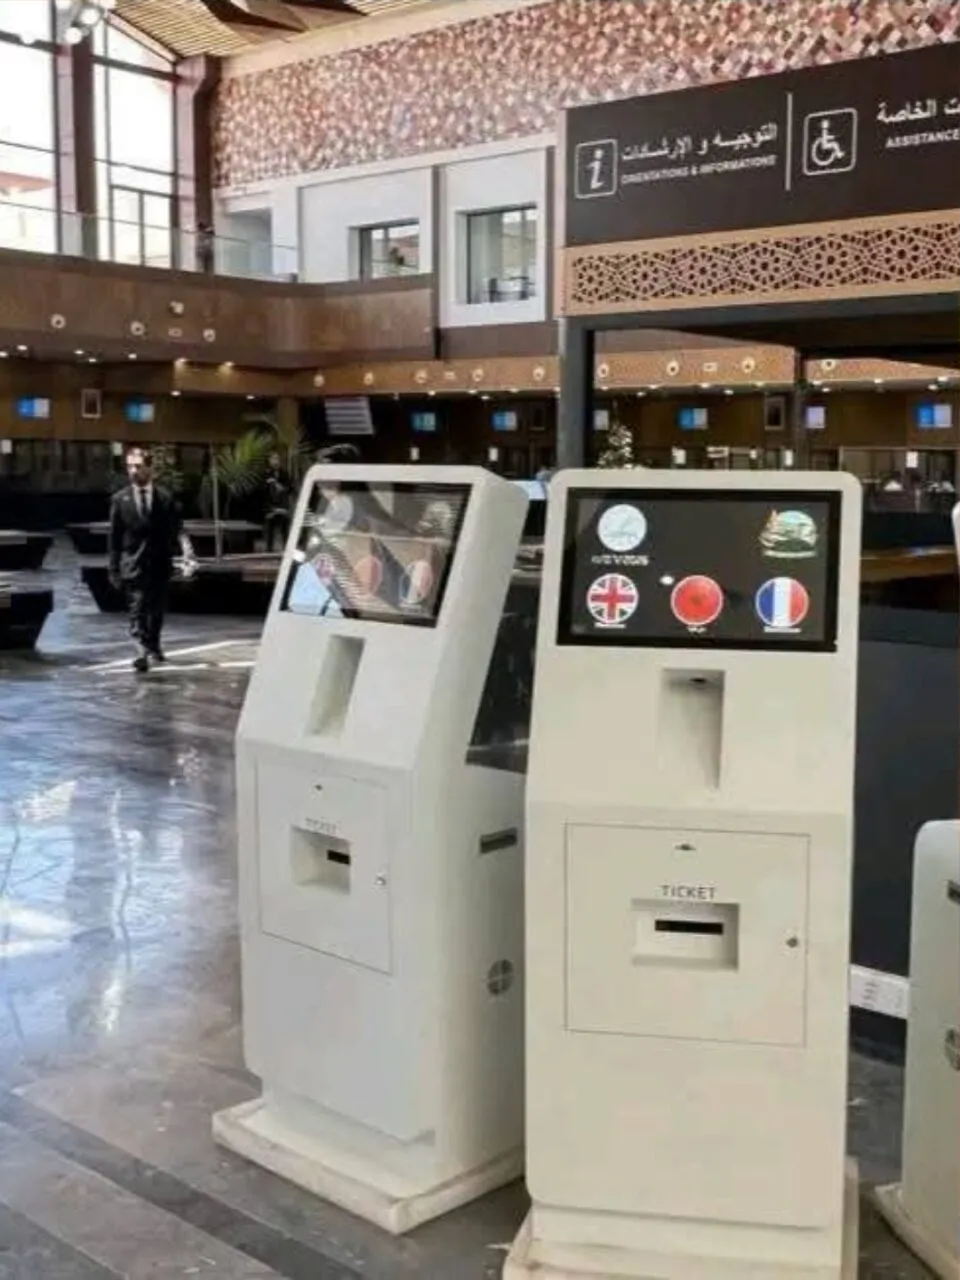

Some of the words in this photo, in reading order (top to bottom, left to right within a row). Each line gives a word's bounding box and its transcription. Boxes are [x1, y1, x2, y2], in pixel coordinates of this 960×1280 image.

[877, 99, 936, 123] الخاصة
[885, 128, 960, 148] ASSISTANCE
[660, 883, 715, 900] TICKET
